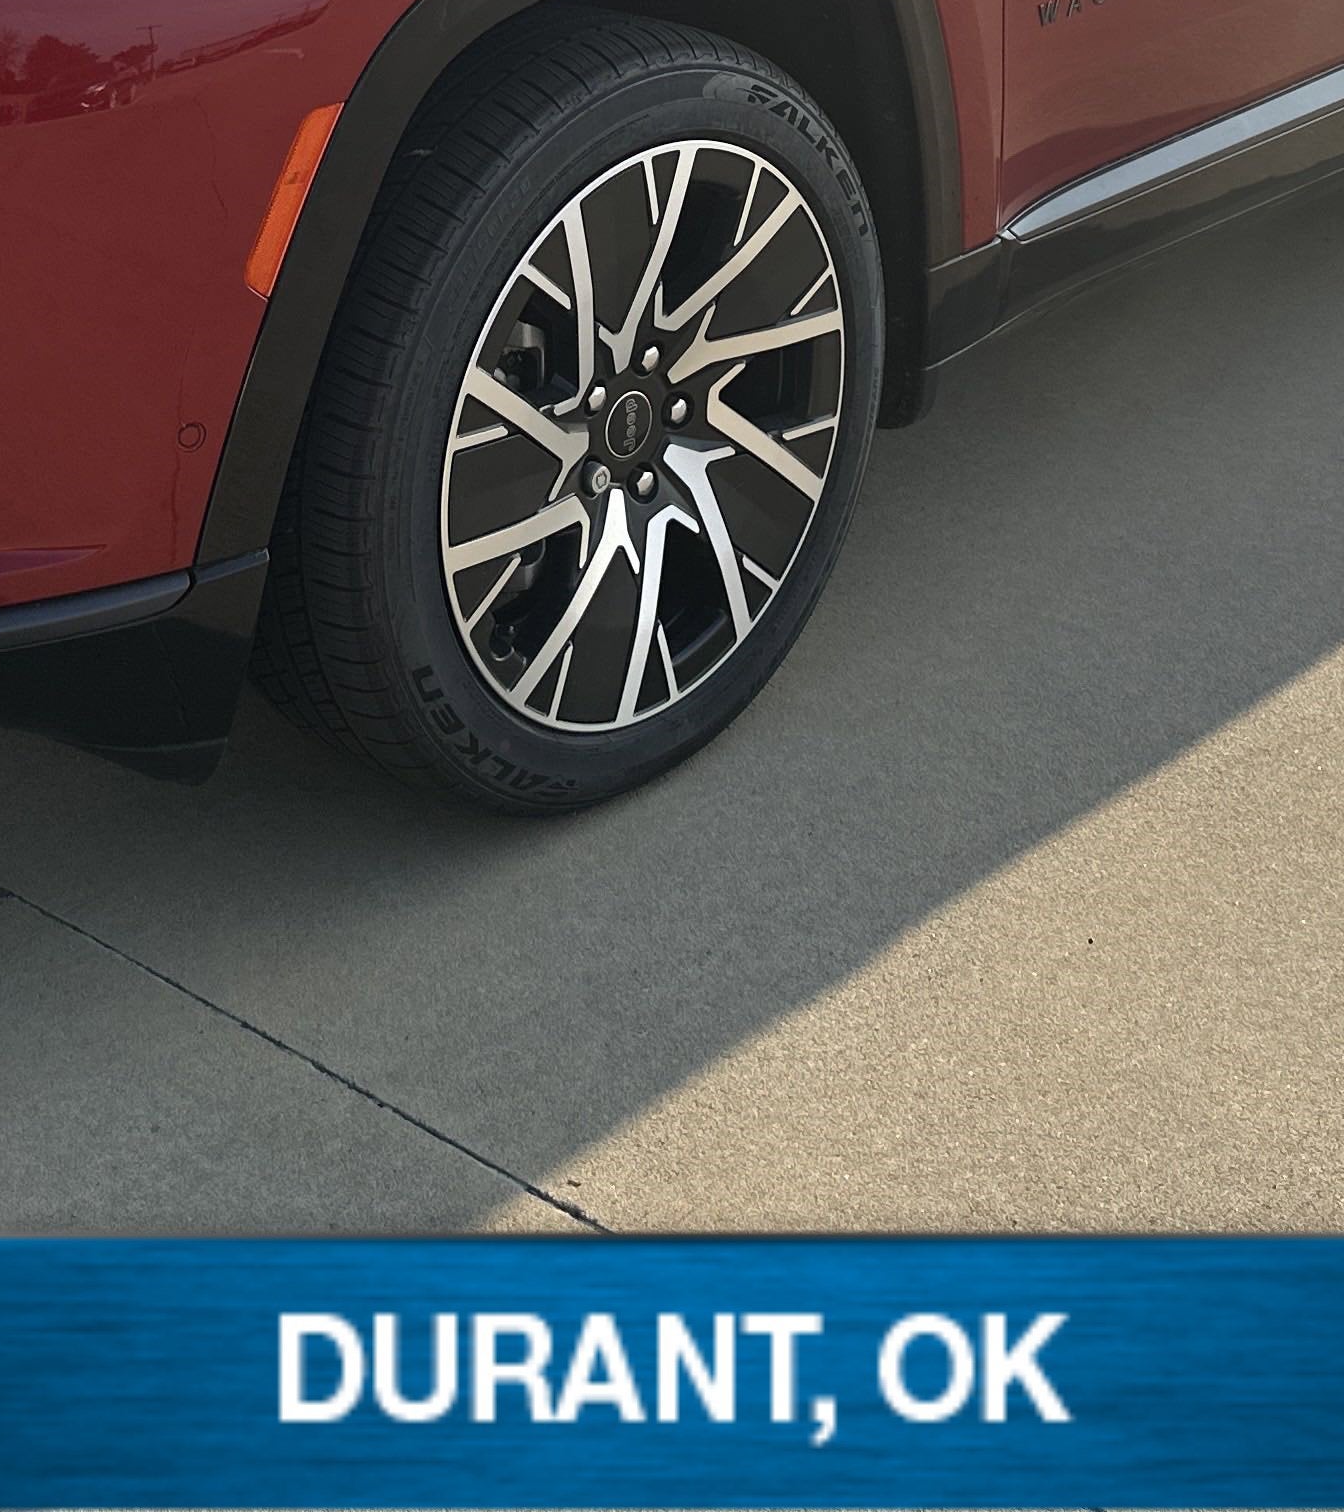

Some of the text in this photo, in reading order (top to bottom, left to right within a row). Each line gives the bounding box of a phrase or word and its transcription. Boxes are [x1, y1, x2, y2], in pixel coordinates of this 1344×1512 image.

[746, 82, 872, 238] FALKEN
[623, 397, 639, 452] Jeep
[412, 663, 579, 798] FALKEN
